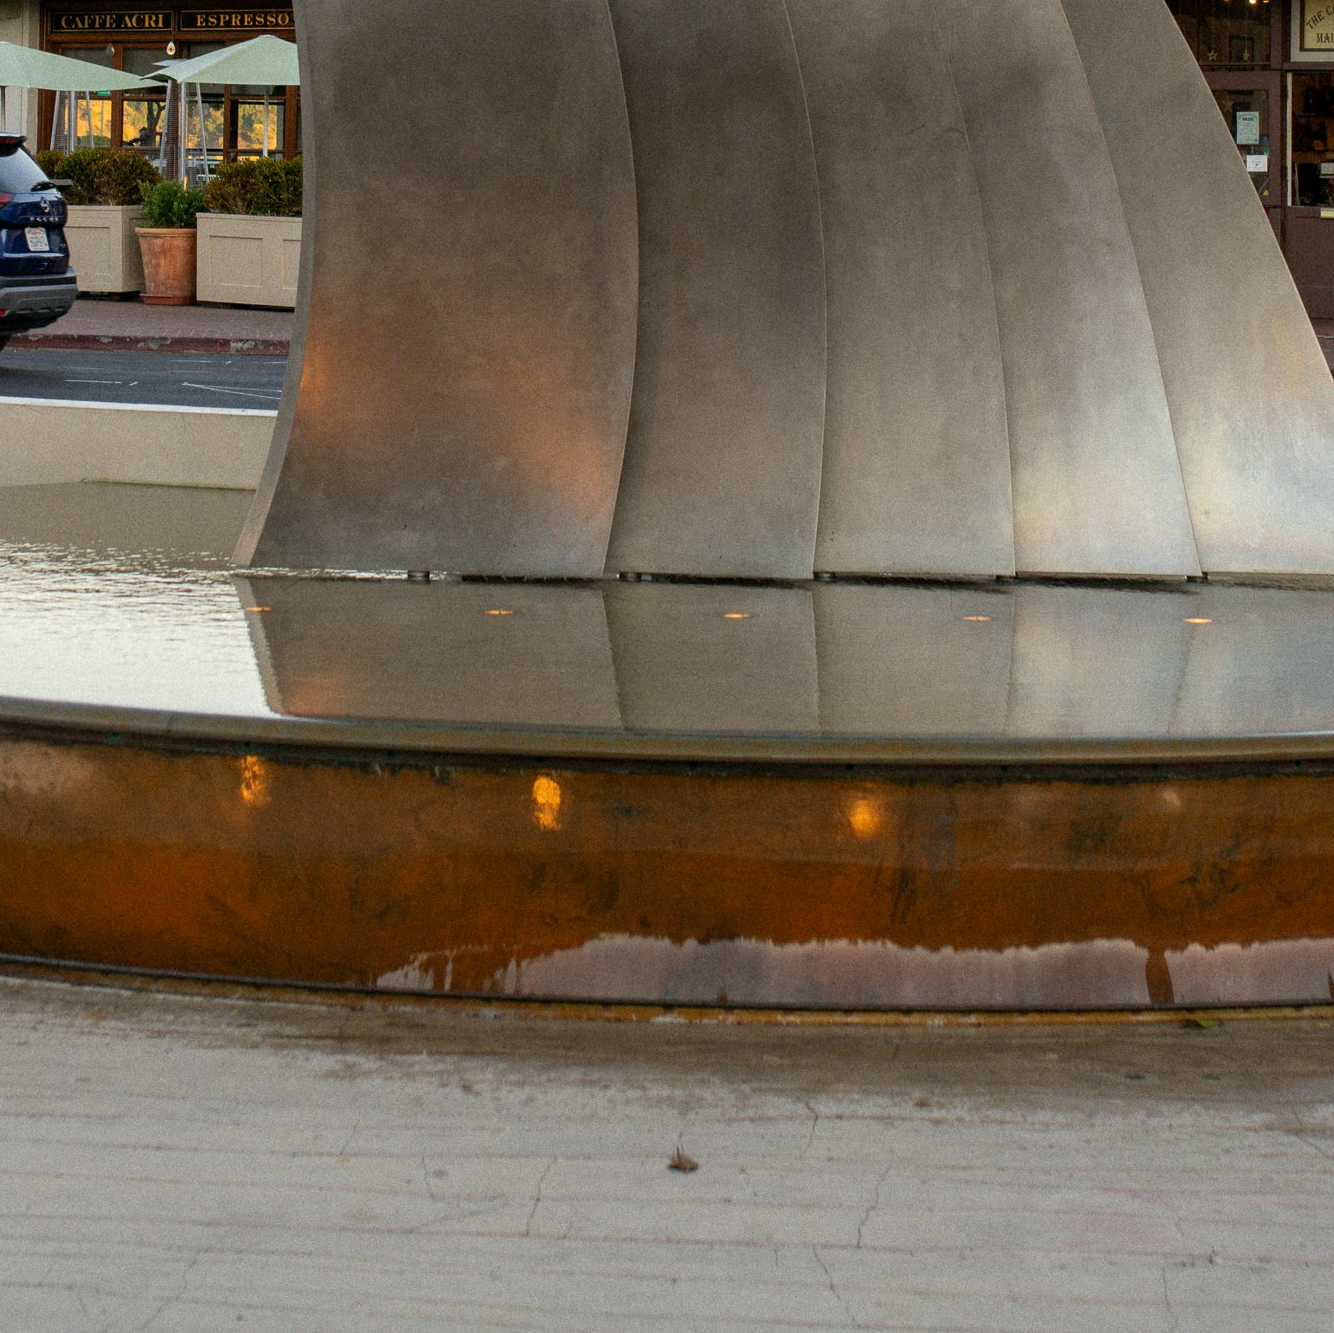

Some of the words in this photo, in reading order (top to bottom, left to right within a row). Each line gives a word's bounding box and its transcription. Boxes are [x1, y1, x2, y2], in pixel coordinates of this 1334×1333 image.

[61, 15, 116, 28] CAFFE
[121, 14, 164, 28] ACRI
[196, 13, 289, 27] ESPRESSO
[1306, 10, 1325, 30] THE
